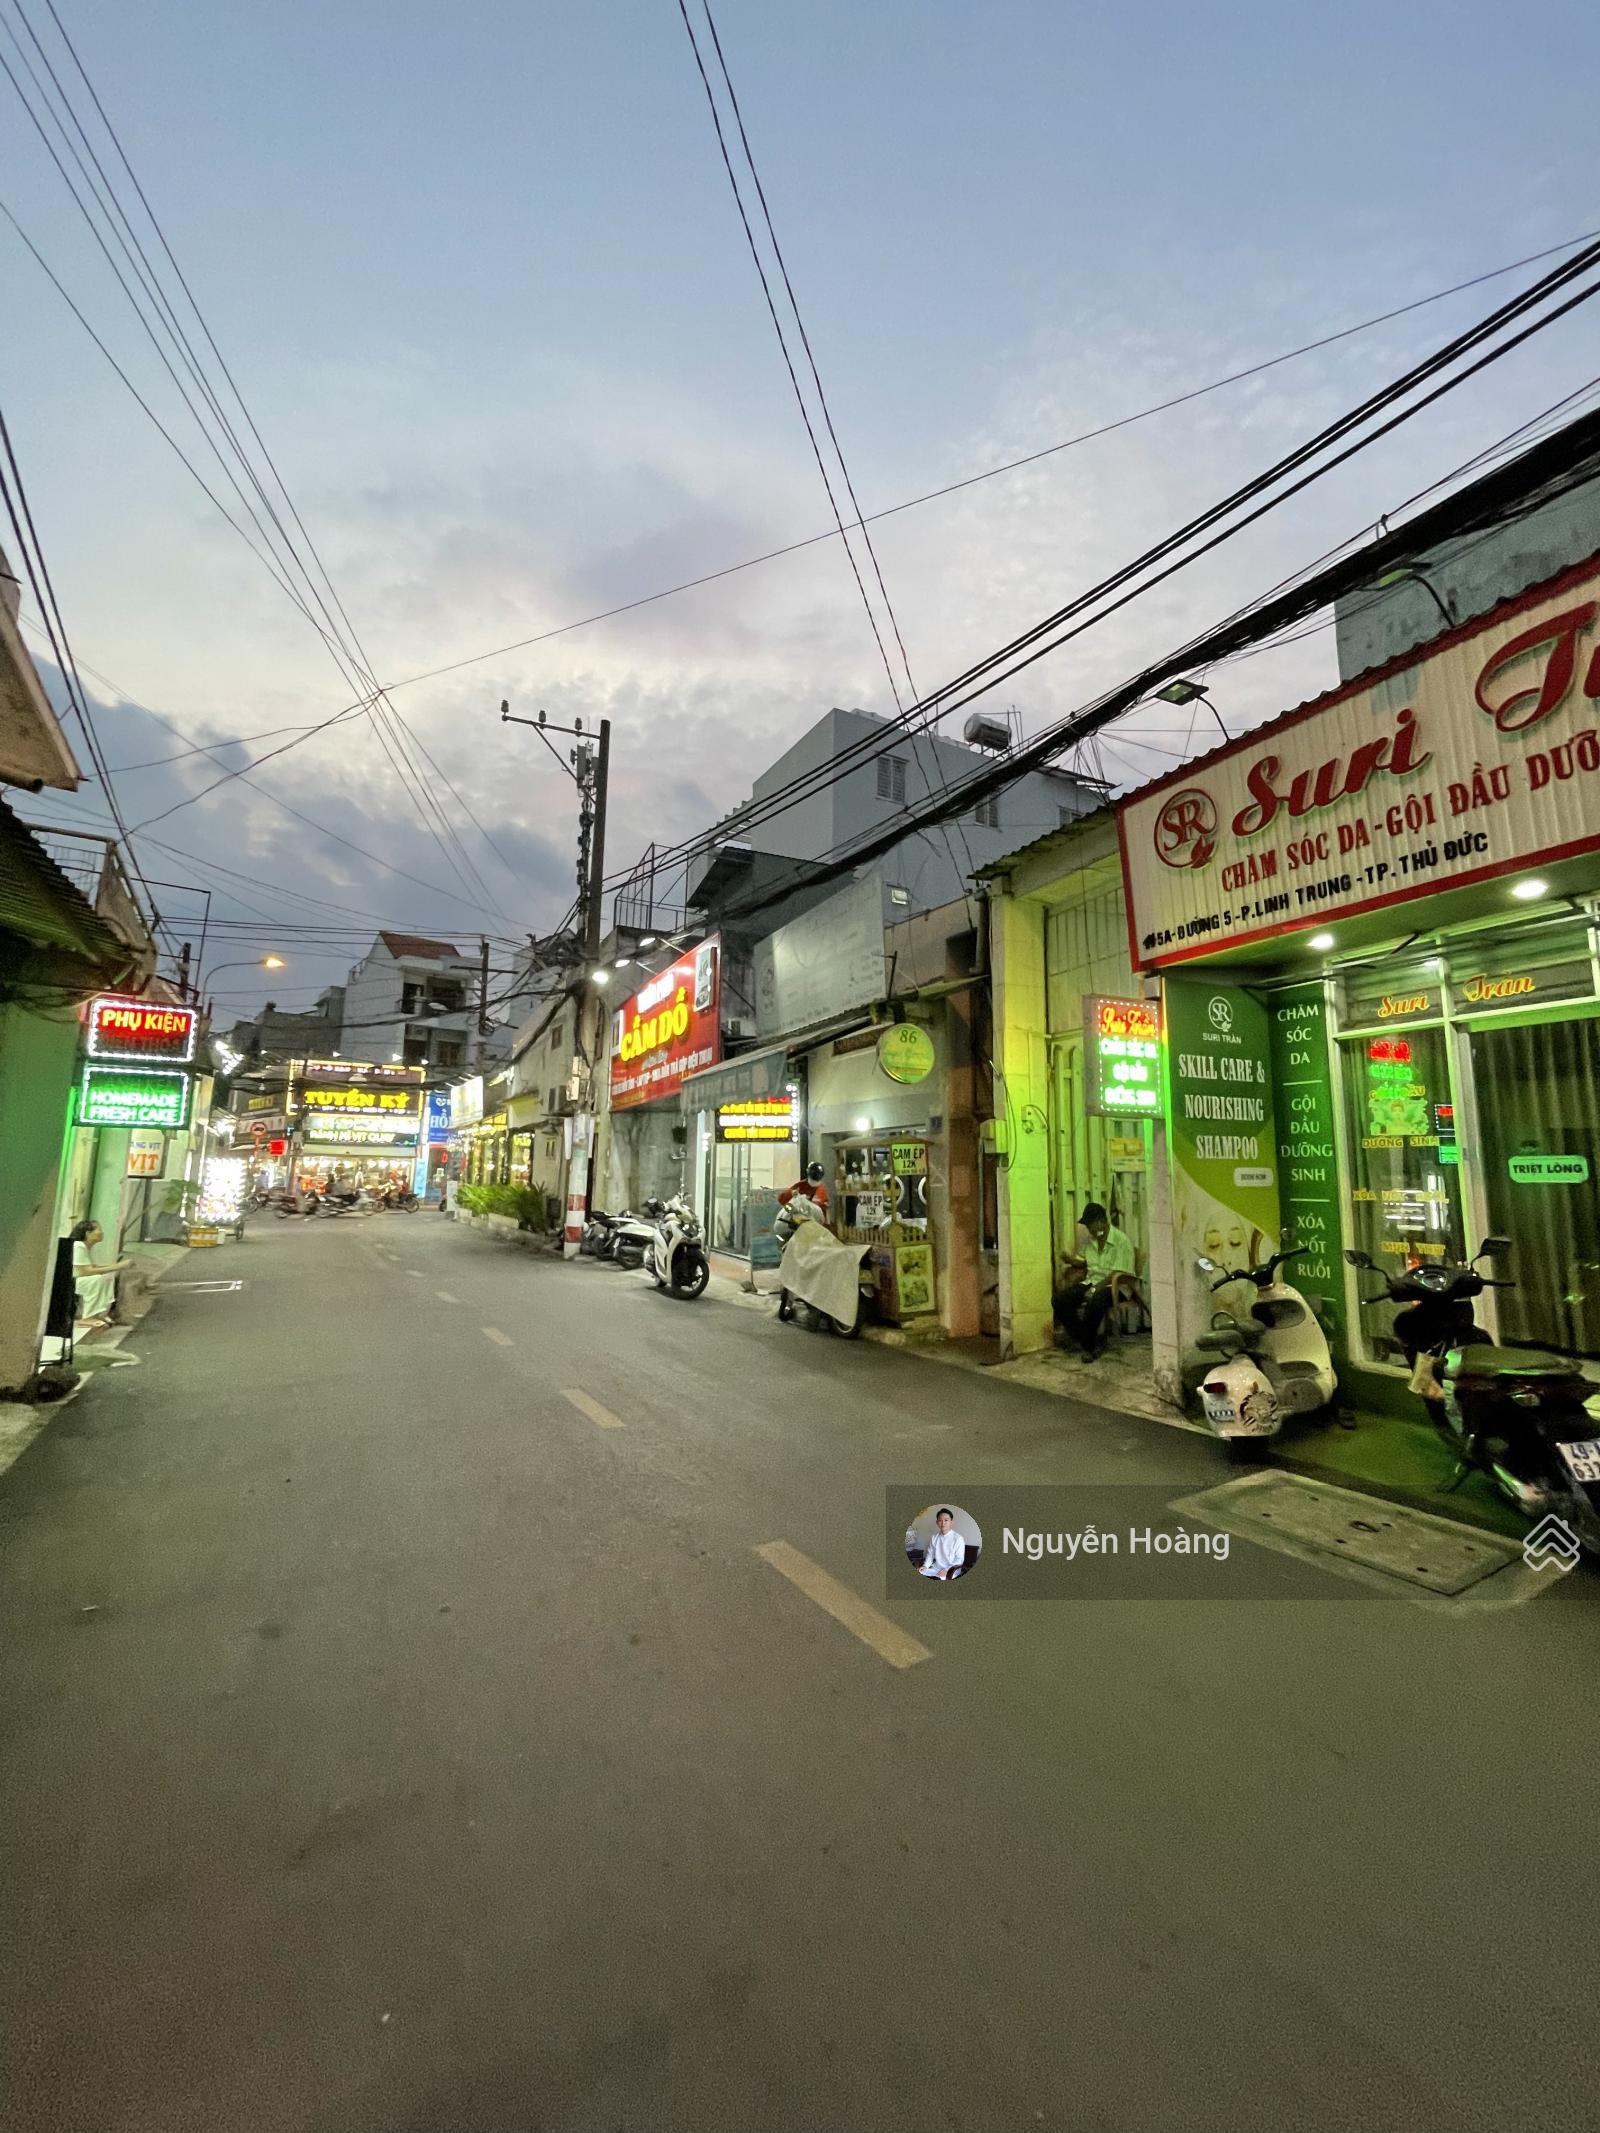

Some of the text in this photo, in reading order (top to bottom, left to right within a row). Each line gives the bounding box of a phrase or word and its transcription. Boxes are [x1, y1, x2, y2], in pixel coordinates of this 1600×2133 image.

[1232, 601, 1600, 837] Suri T
[1286, 831, 1328, 871] SÓC
[1447, 762, 1509, 816] ĐẦU
[1224, 910, 1231, 925] 5
[1295, 875, 1351, 905] TRUNG
[1399, 839, 1437, 873] THỦ
[1443, 830, 1488, 860] ĐỨC
[1277, 1004, 1319, 1022] CHĂM
[1378, 994, 1430, 1017] Suri
[102, 1010, 187, 1033] PHỤ KIỆN
[900, 1029, 917, 1044] 86
[1202, 1032, 1220, 1042] SURI
[1286, 1026, 1312, 1043] SÓC
[1290, 1052, 1310, 1065] DA
[1179, 1053, 1217, 1081] SKILL
[1220, 1056, 1253, 1082] CARE
[1257, 1060, 1265, 1083] &
[90, 1091, 180, 1108] HOMEMADE
[1184, 1095, 1264, 1121] NOURISHING
[1291, 1094, 1316, 1112] GỘI
[90, 1106, 179, 1122] FRESH CAKE
[1290, 1118, 1320, 1134] ĐẦU
[893, 1148, 911, 1160] CAM
[1196, 1135, 1258, 1160] SHAMPOO
[1281, 1143, 1333, 1158] DƯỠNG
[129, 1153, 160, 1173] VỊT
[1291, 1168, 1326, 1181] SINH
[1297, 1212, 1326, 1230] XÓA
